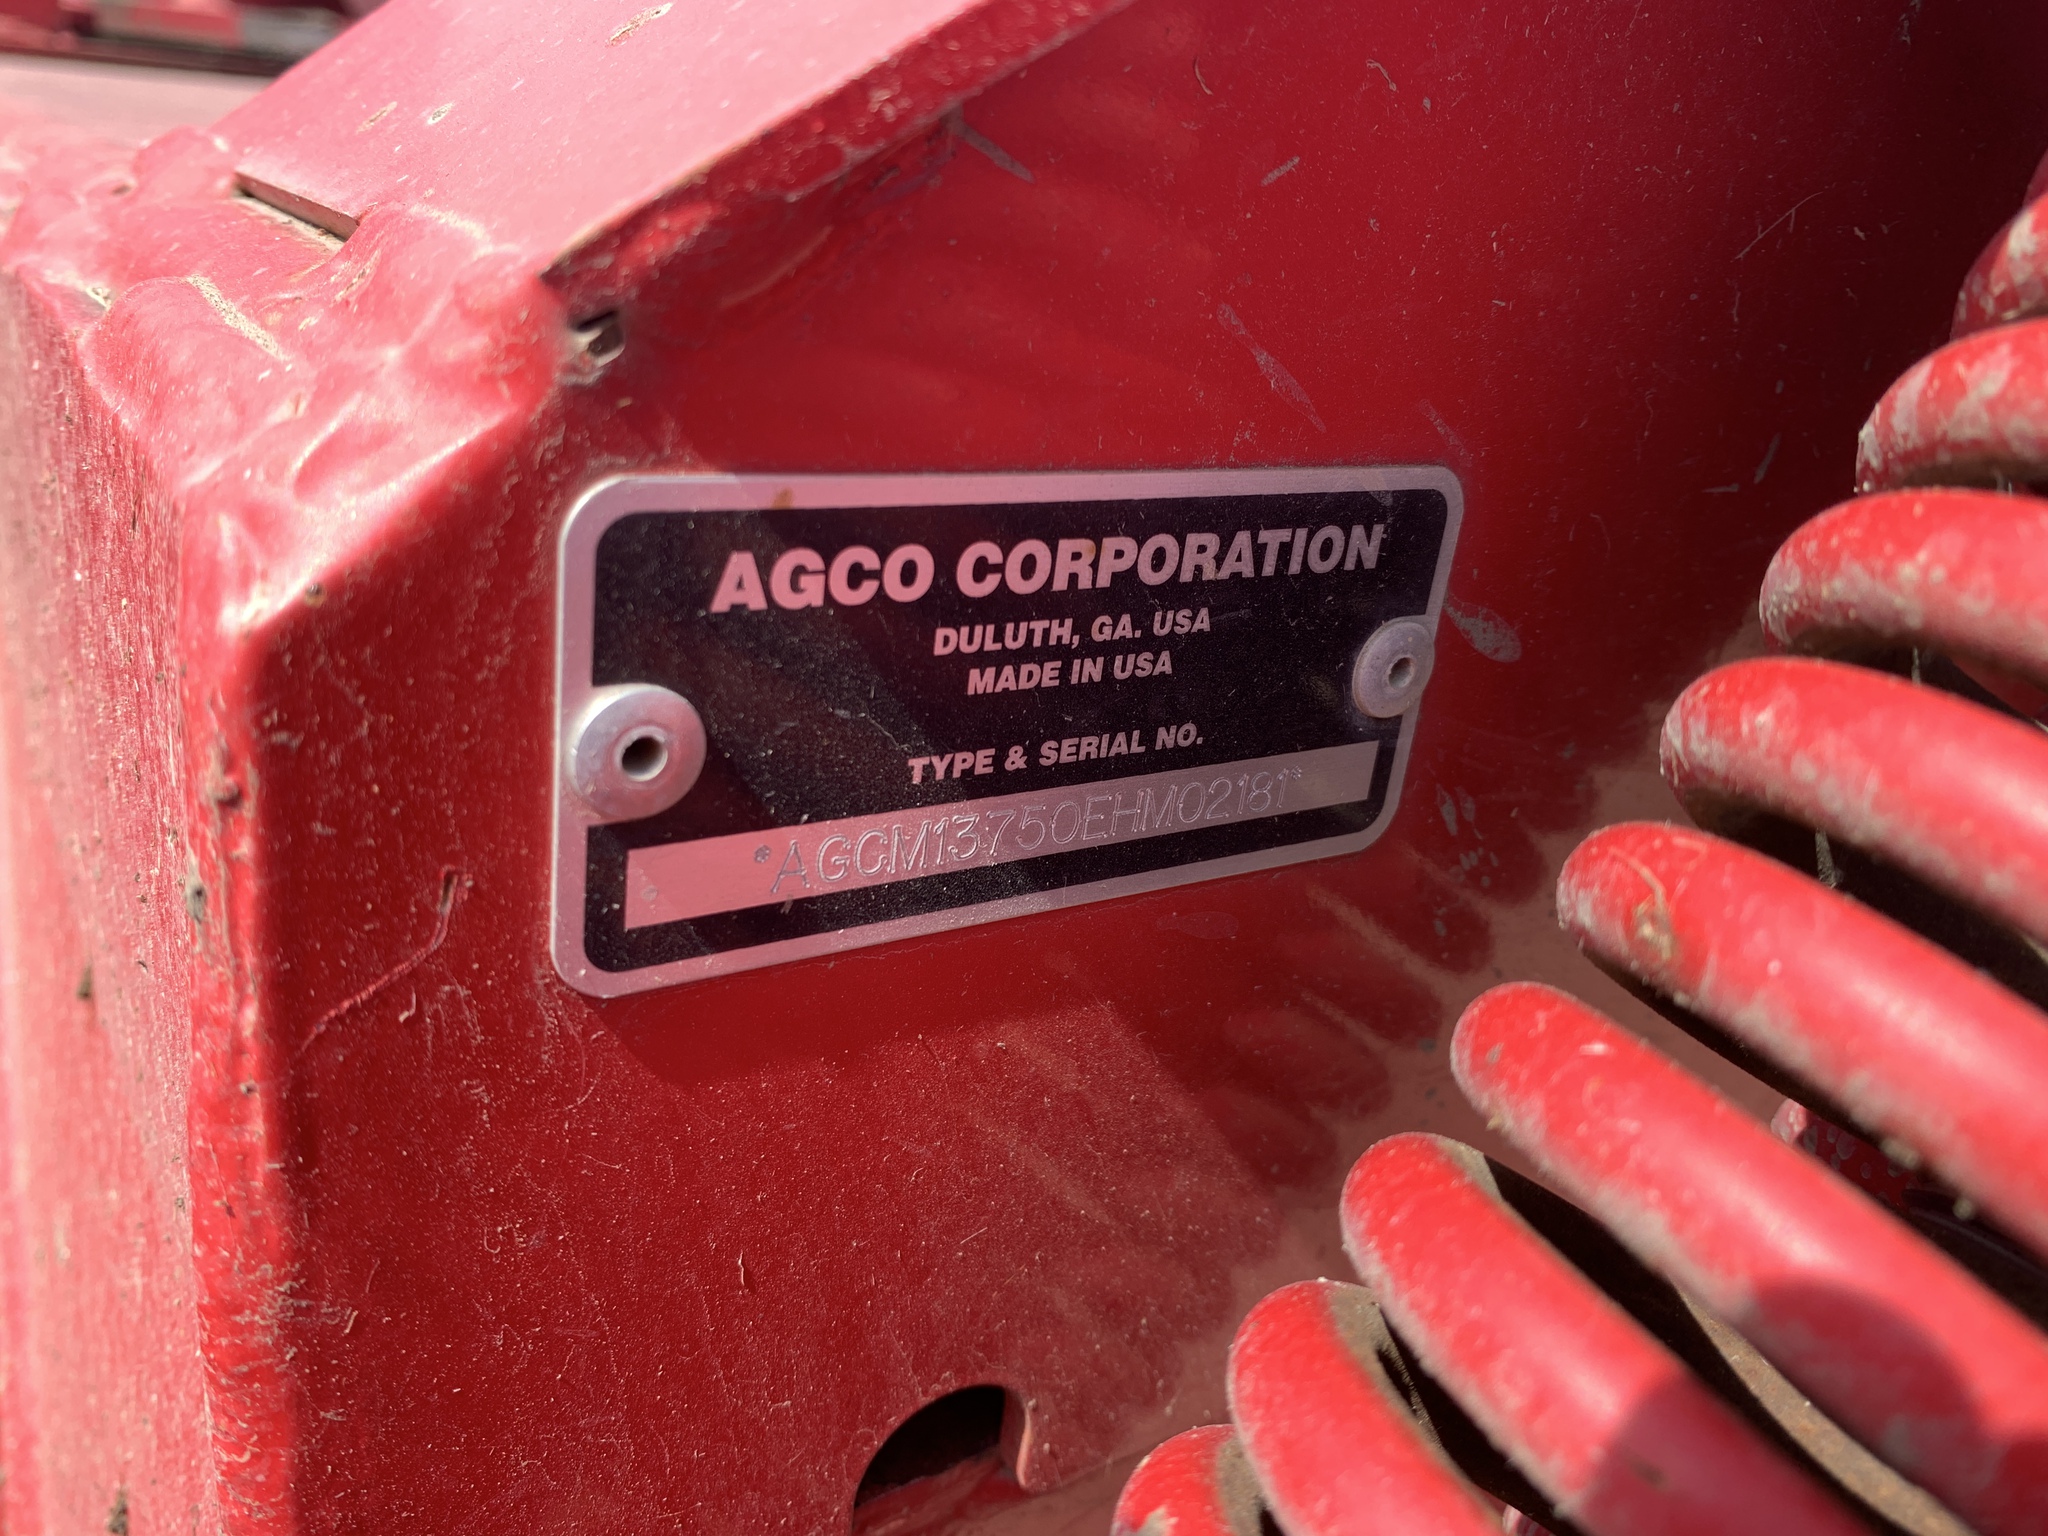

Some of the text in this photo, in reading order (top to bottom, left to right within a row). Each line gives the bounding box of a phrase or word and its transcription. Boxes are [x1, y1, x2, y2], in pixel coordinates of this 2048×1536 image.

[711, 523, 1386, 612] AGCO CORPORATION
[934, 608, 1211, 655] DULUTH, GA. USA
[967, 651, 1173, 695] MADE IN USA
[908, 722, 1204, 784] TYPE & SERIAL NO.
